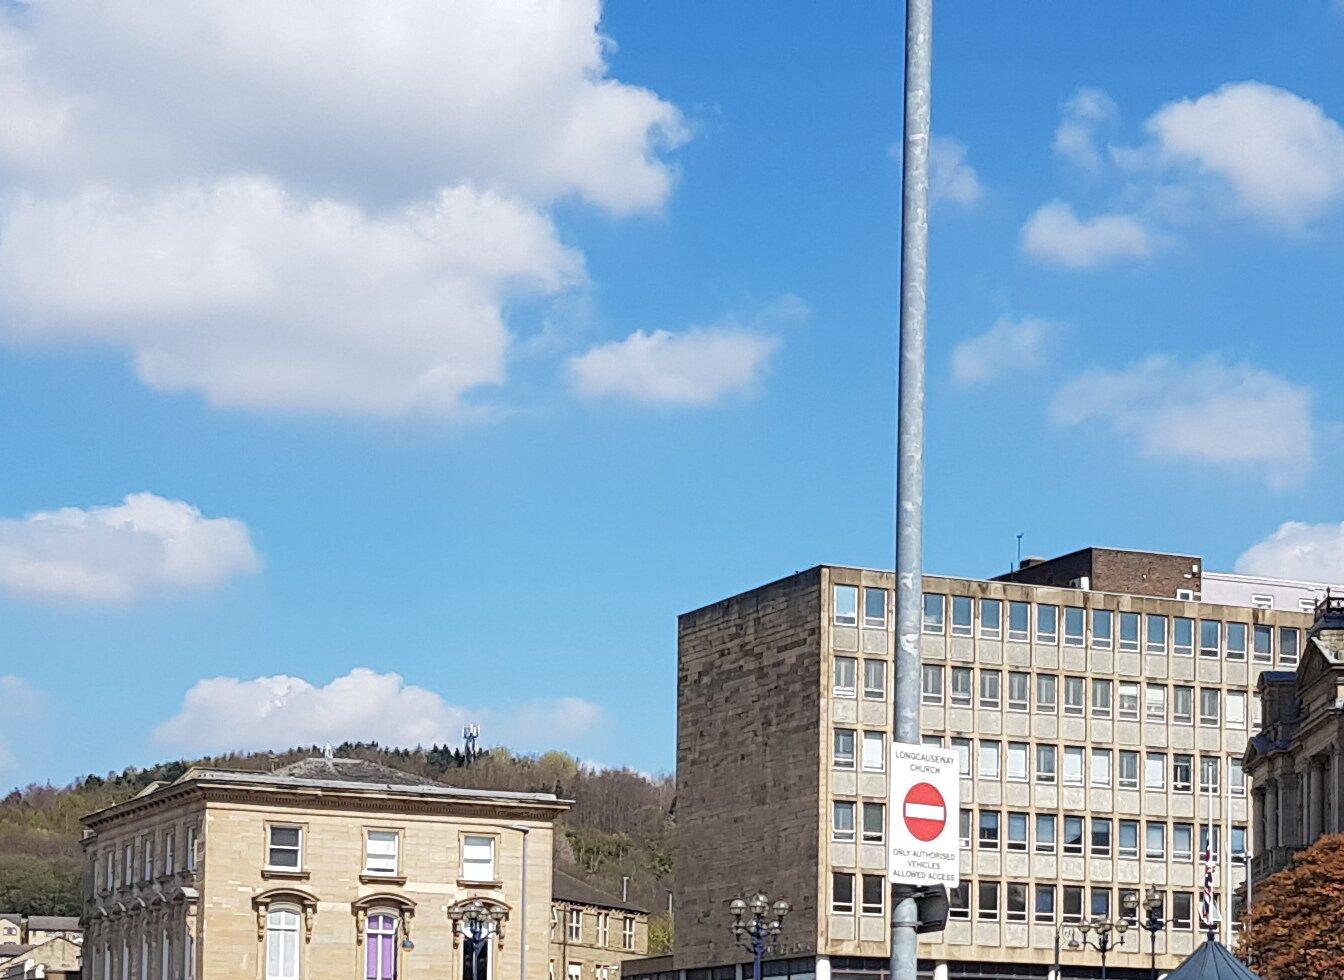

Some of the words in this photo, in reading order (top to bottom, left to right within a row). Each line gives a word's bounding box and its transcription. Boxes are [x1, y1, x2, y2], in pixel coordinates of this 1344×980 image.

[895, 750, 955, 765] LONGCAUSEWAY
[909, 763, 941, 774] CHURCH
[892, 848, 911, 857] ONLY
[912, 850, 956, 861] AUTHORISED
[907, 860, 941, 870] VEHICLES
[892, 869, 927, 879] ALLOWED
[927, 872, 955, 882] ACCESS
